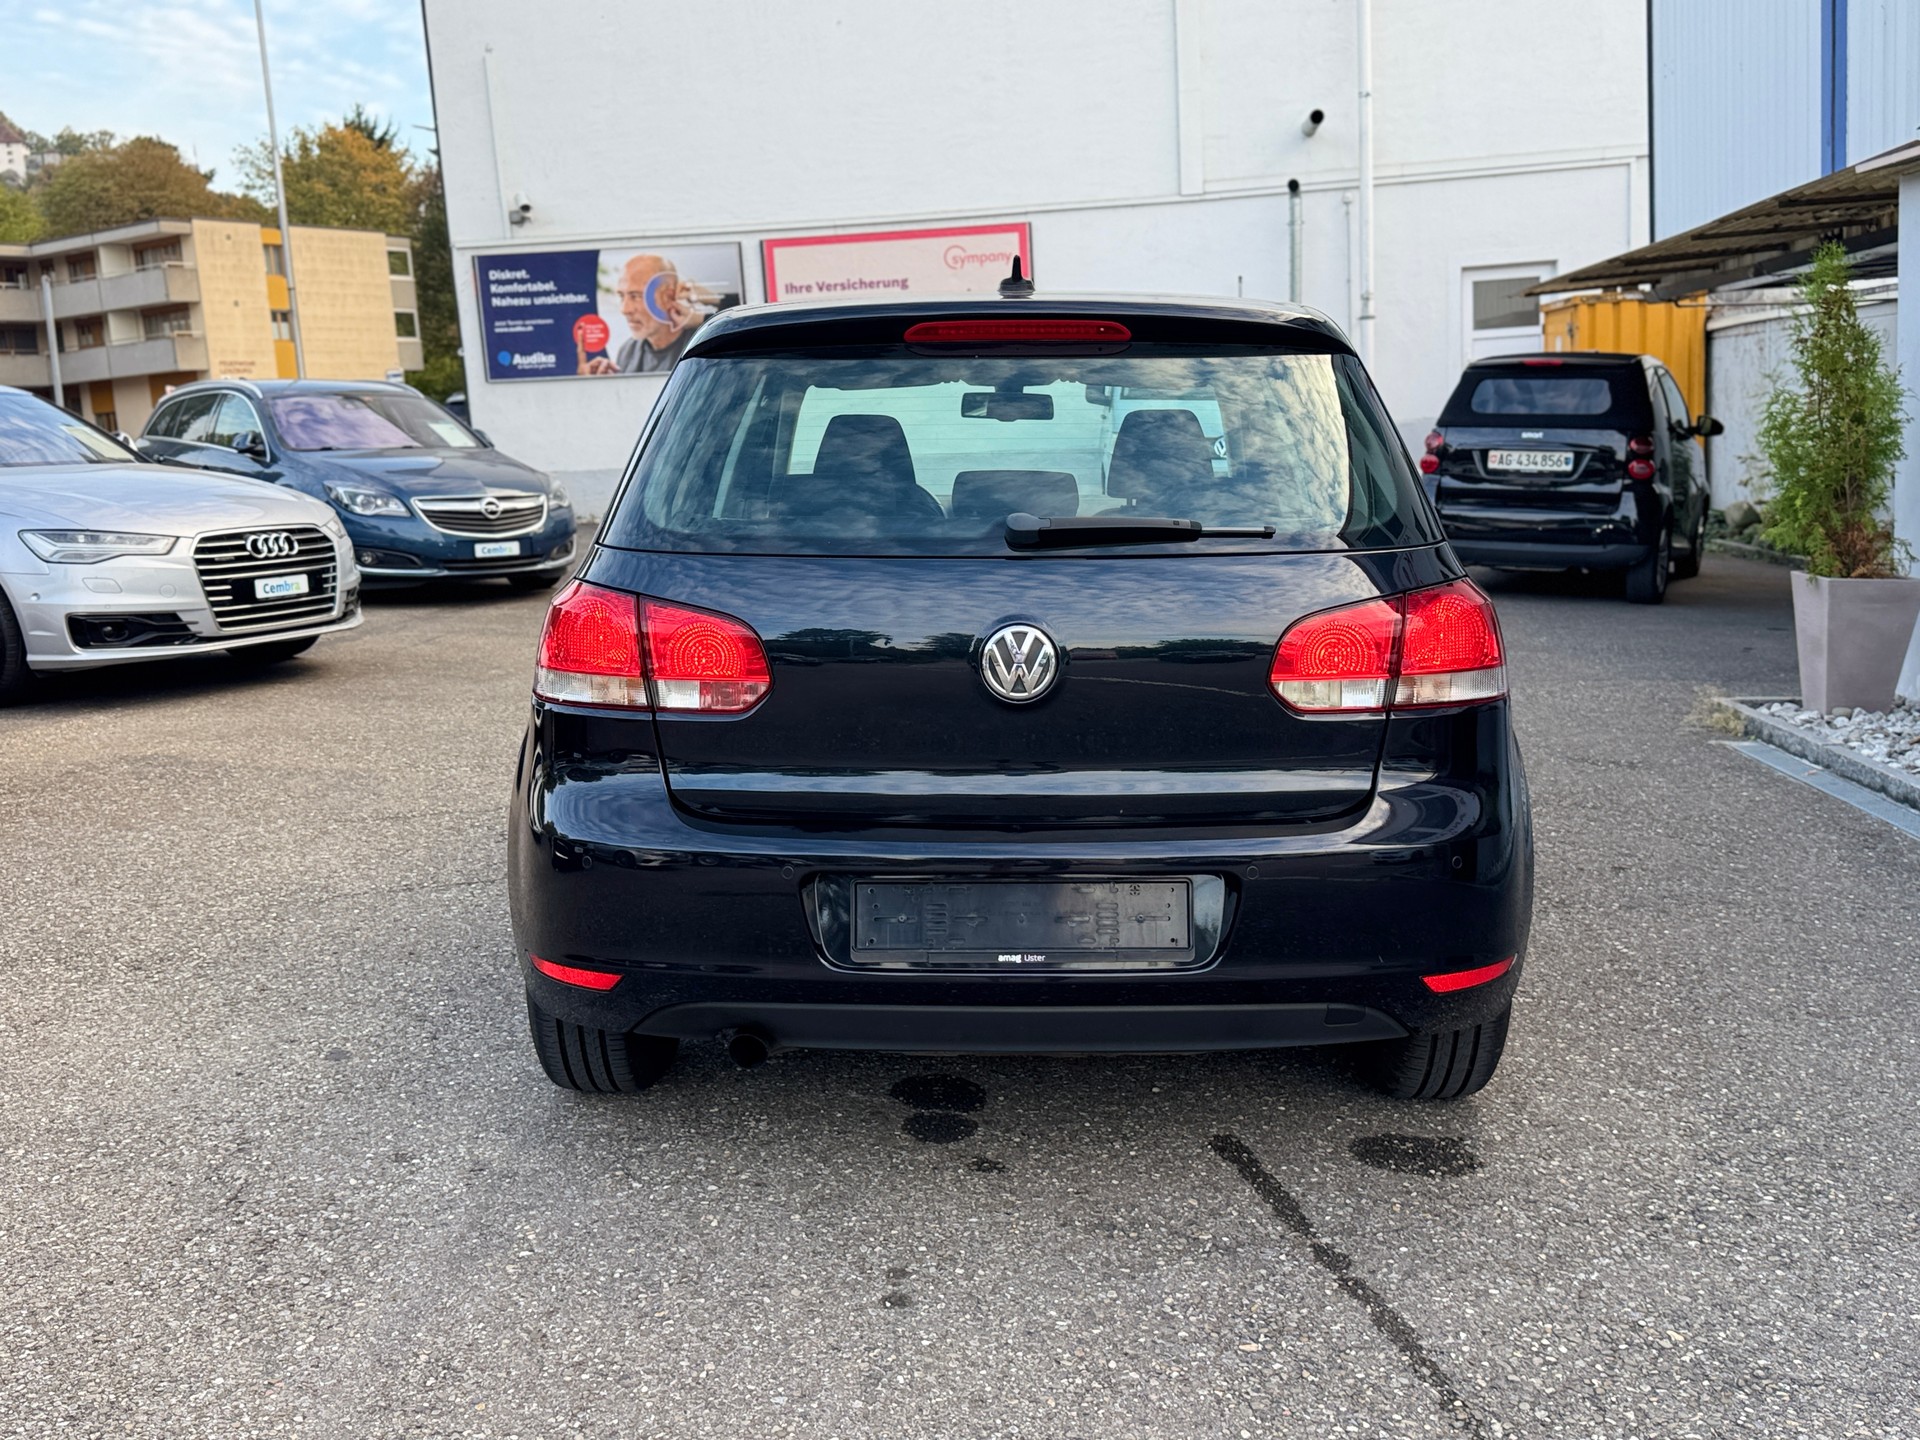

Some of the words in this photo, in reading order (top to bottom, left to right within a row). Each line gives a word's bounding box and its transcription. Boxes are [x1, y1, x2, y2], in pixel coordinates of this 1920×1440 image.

[951, 251, 1012, 269] sympany
[488, 269, 530, 280] Diskret.
[490, 280, 558, 294] Komfortabel.
[784, 282, 813, 294] Ihre
[816, 278, 909, 293] Versicherung
[491, 296, 531, 307] Nahezu
[533, 293, 590, 305] unsichtbar.
[512, 351, 557, 365] Audika
[481, 546, 513, 554] Cembra
[263, 581, 301, 594] Cembra
[998, 954, 1021, 963] amag
[1024, 954, 1046, 962] Uster
